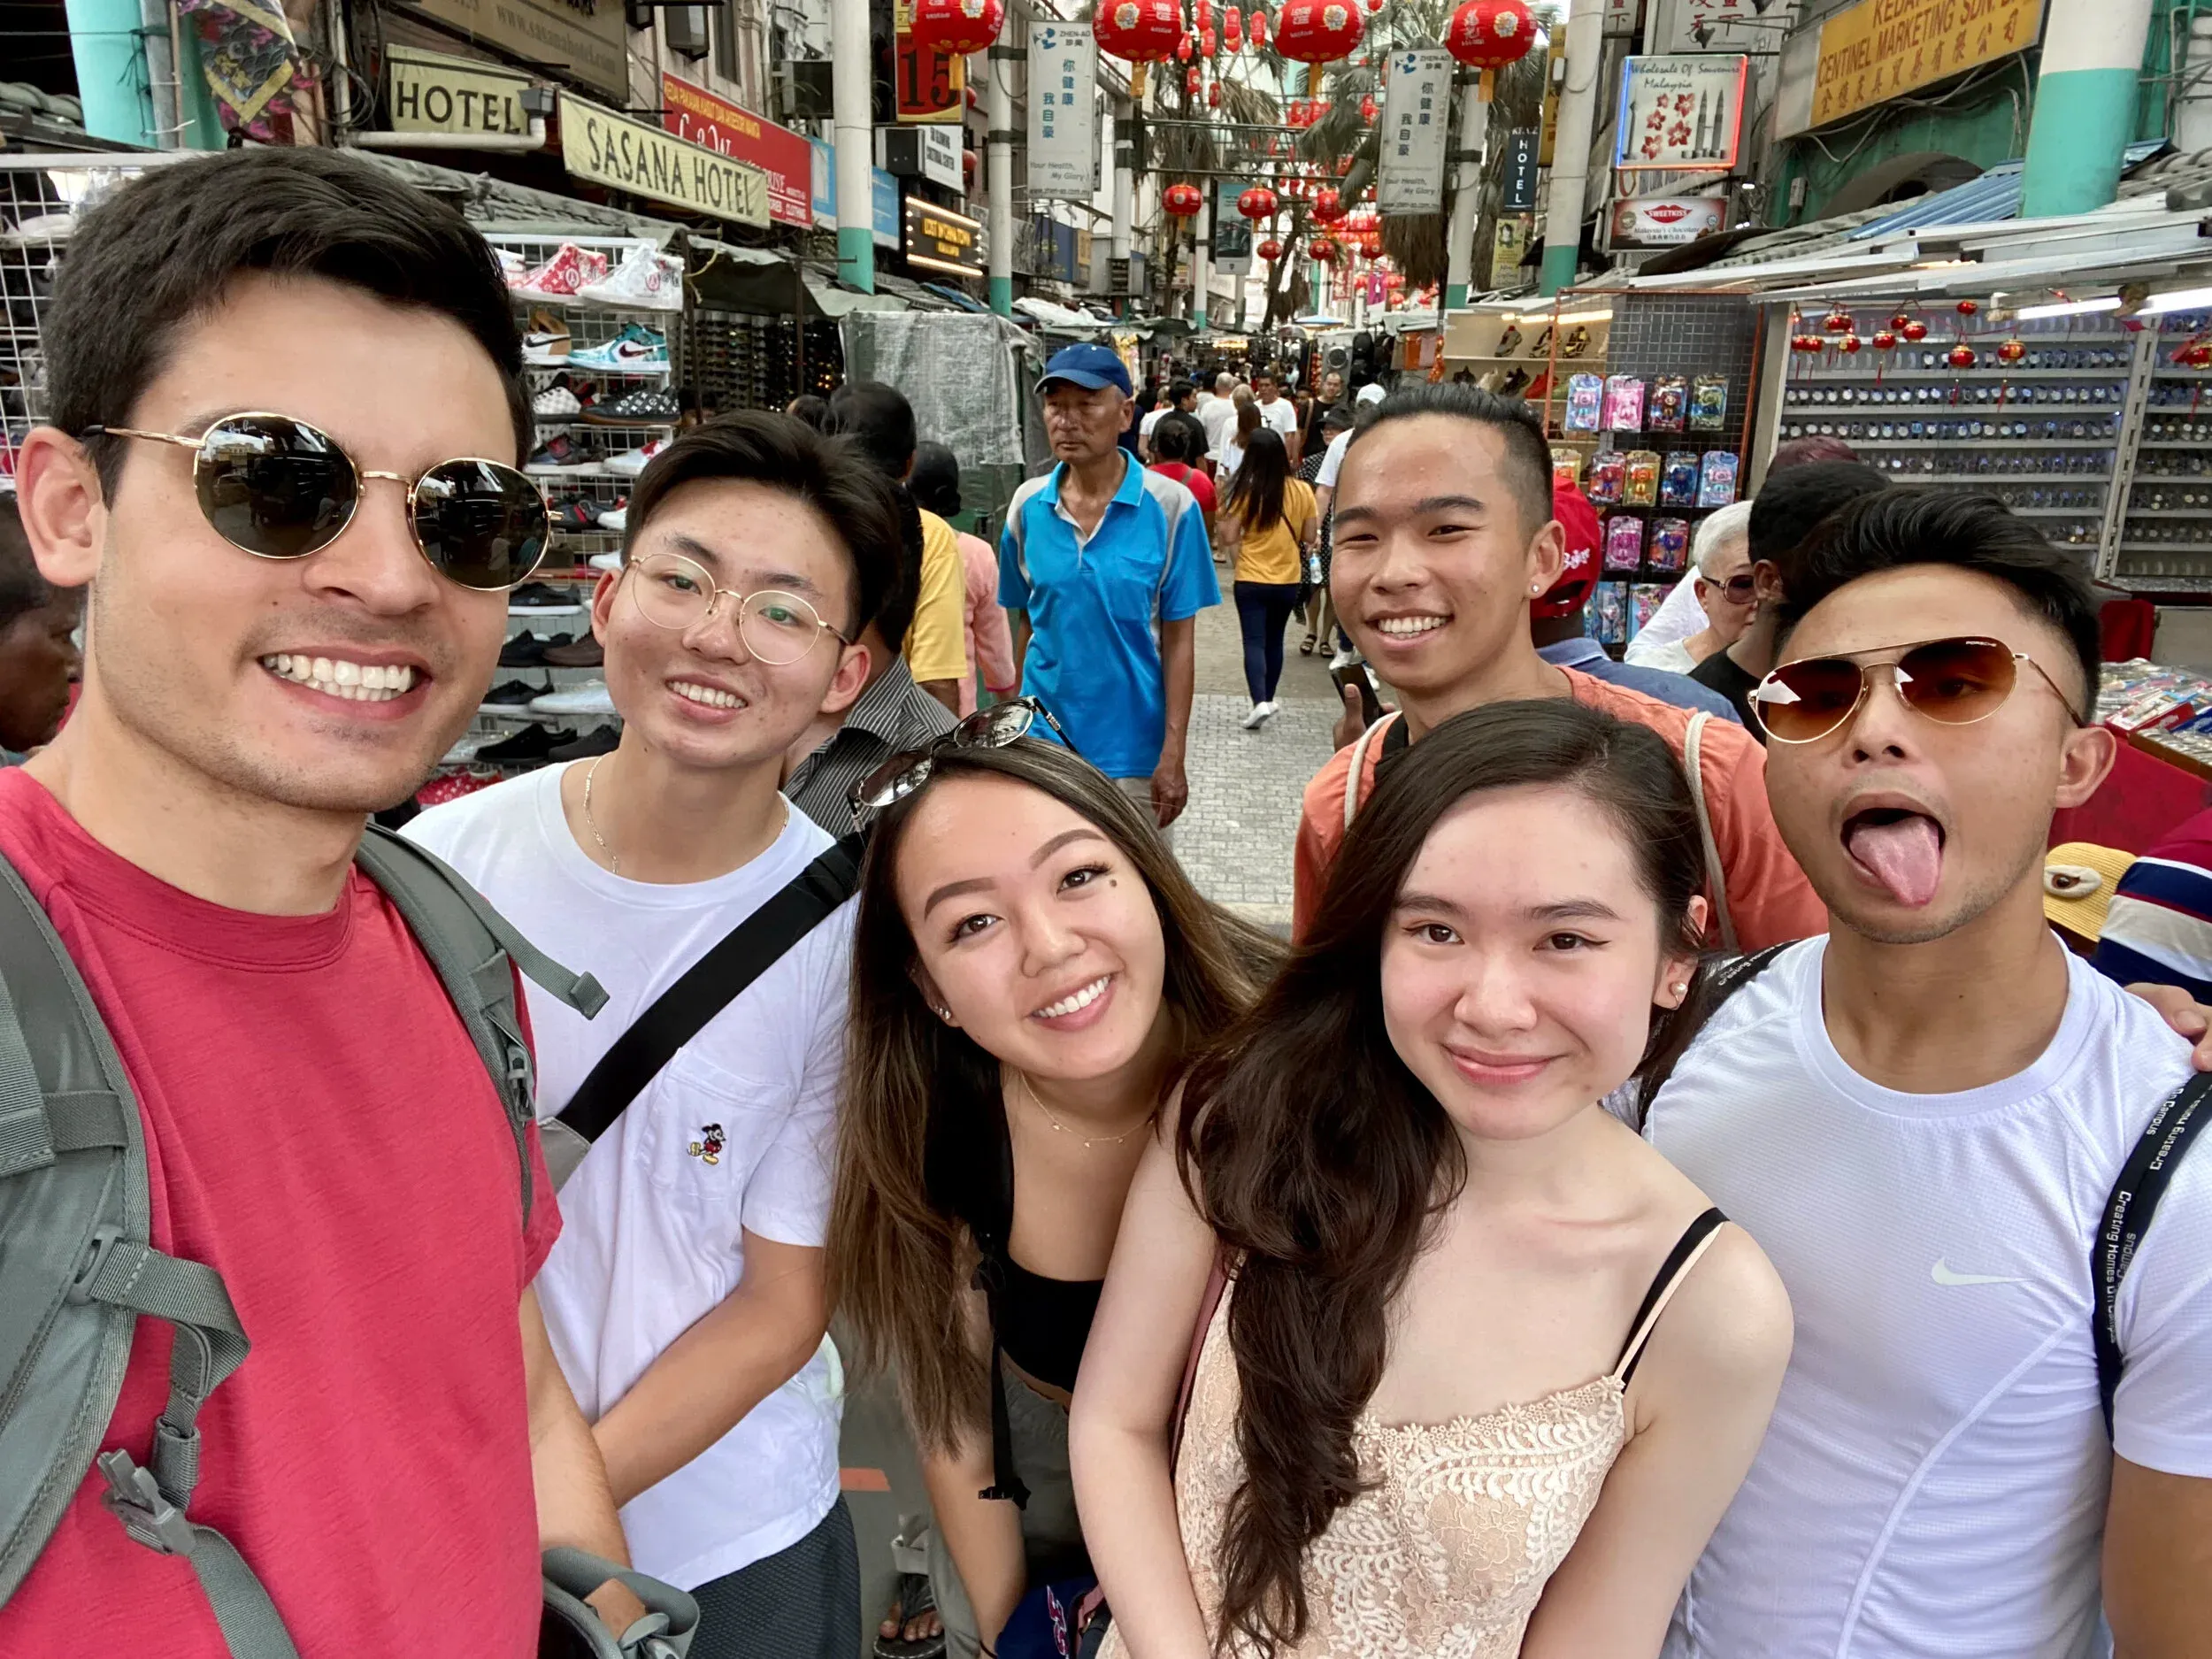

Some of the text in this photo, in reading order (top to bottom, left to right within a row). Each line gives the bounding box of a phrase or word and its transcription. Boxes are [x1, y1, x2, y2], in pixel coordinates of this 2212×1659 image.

[1875, 0, 1953, 64] MARKETING
[1632, 63, 1678, 74] Wholesale
[1644, 77, 1693, 93] Malaysia
[396, 81, 521, 134] HOTEL
[586, 117, 687, 199] SASANA
[692, 156, 755, 218] HOTEL
[1514, 139, 1529, 204] HOTEL
[2149, 1125, 2185, 1171] Creating
[2107, 1190, 2132, 1241] Creating
[2107, 1244, 2119, 1283] Homes
